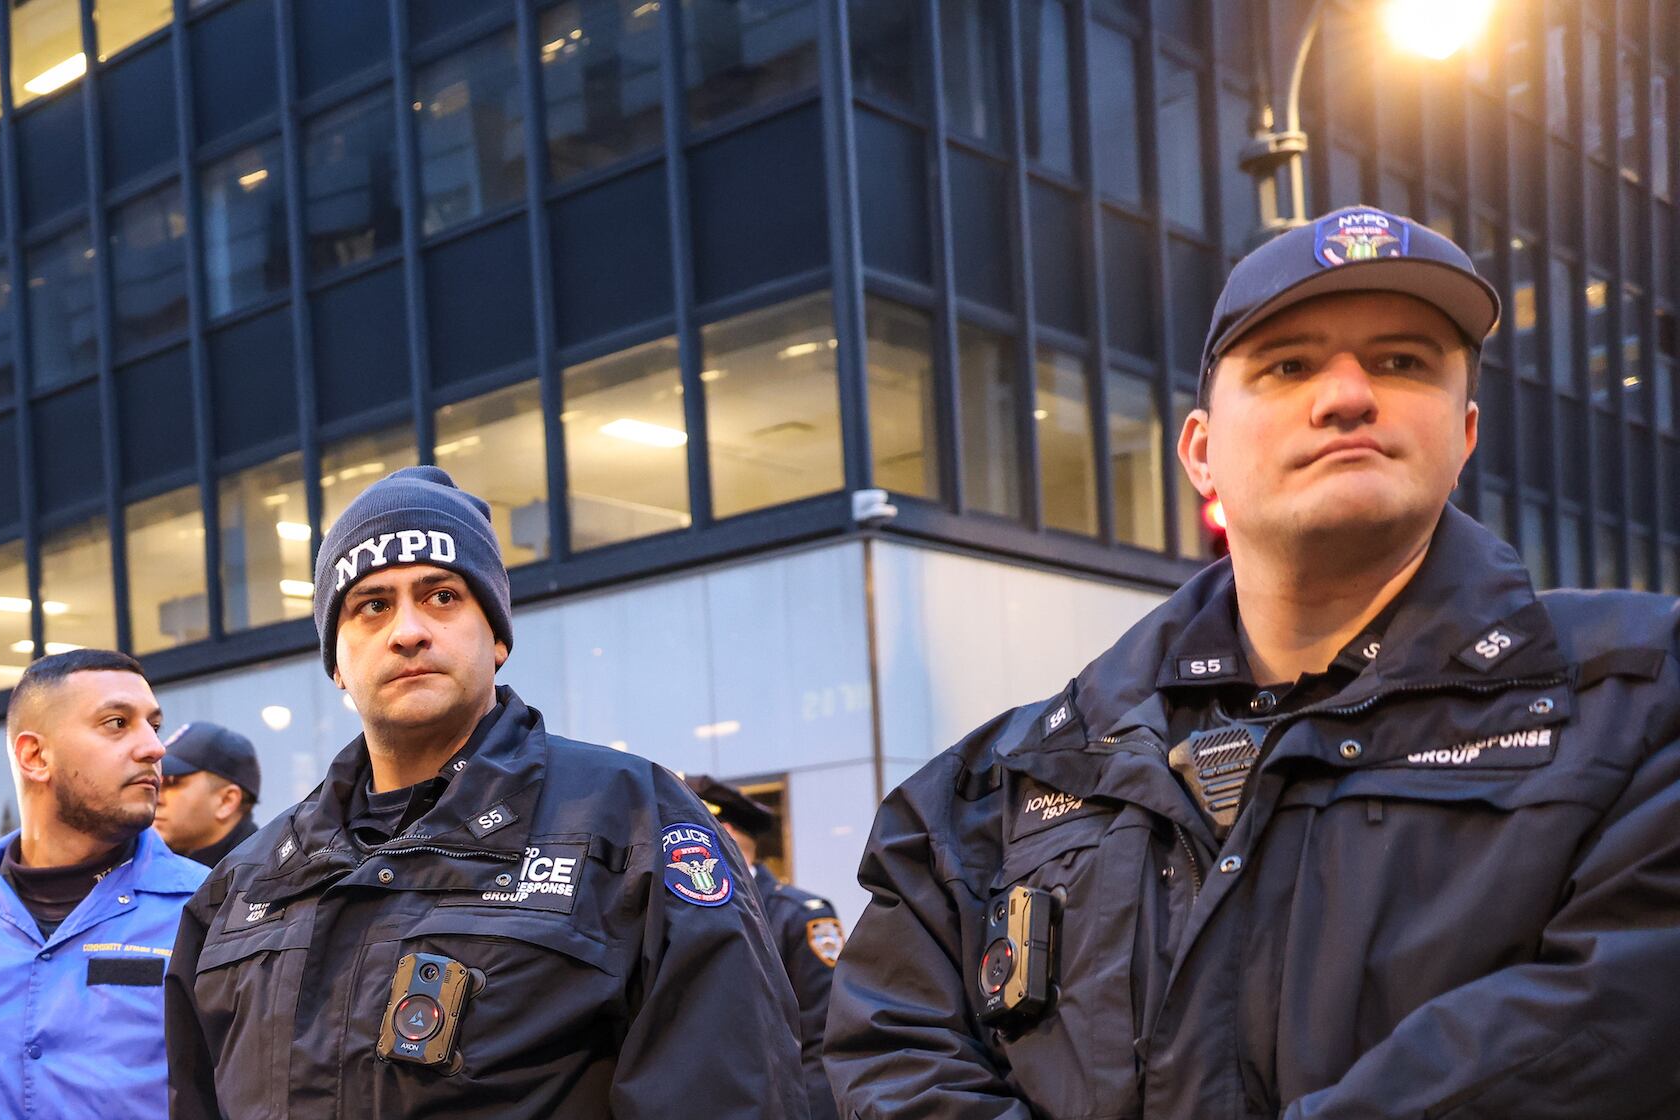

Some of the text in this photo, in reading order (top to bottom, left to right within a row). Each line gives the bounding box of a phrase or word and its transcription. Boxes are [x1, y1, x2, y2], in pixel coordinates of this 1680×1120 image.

[1338, 213, 1390, 229] NYPD
[335, 529, 457, 592] NYPD
[1474, 630, 1512, 659] S5
[1190, 658, 1222, 675] S5
[1049, 706, 1067, 729] S5
[1199, 739, 1248, 757] MOTOROLA
[478, 809, 503, 829] S5
[1041, 799, 1084, 821] 19374
[280, 840, 293, 858] S5
[662, 829, 712, 853] POLICE
[516, 882, 574, 897] ESPONSE
[986, 995, 1001, 1008] AXON
[400, 1041, 420, 1051] AXON
